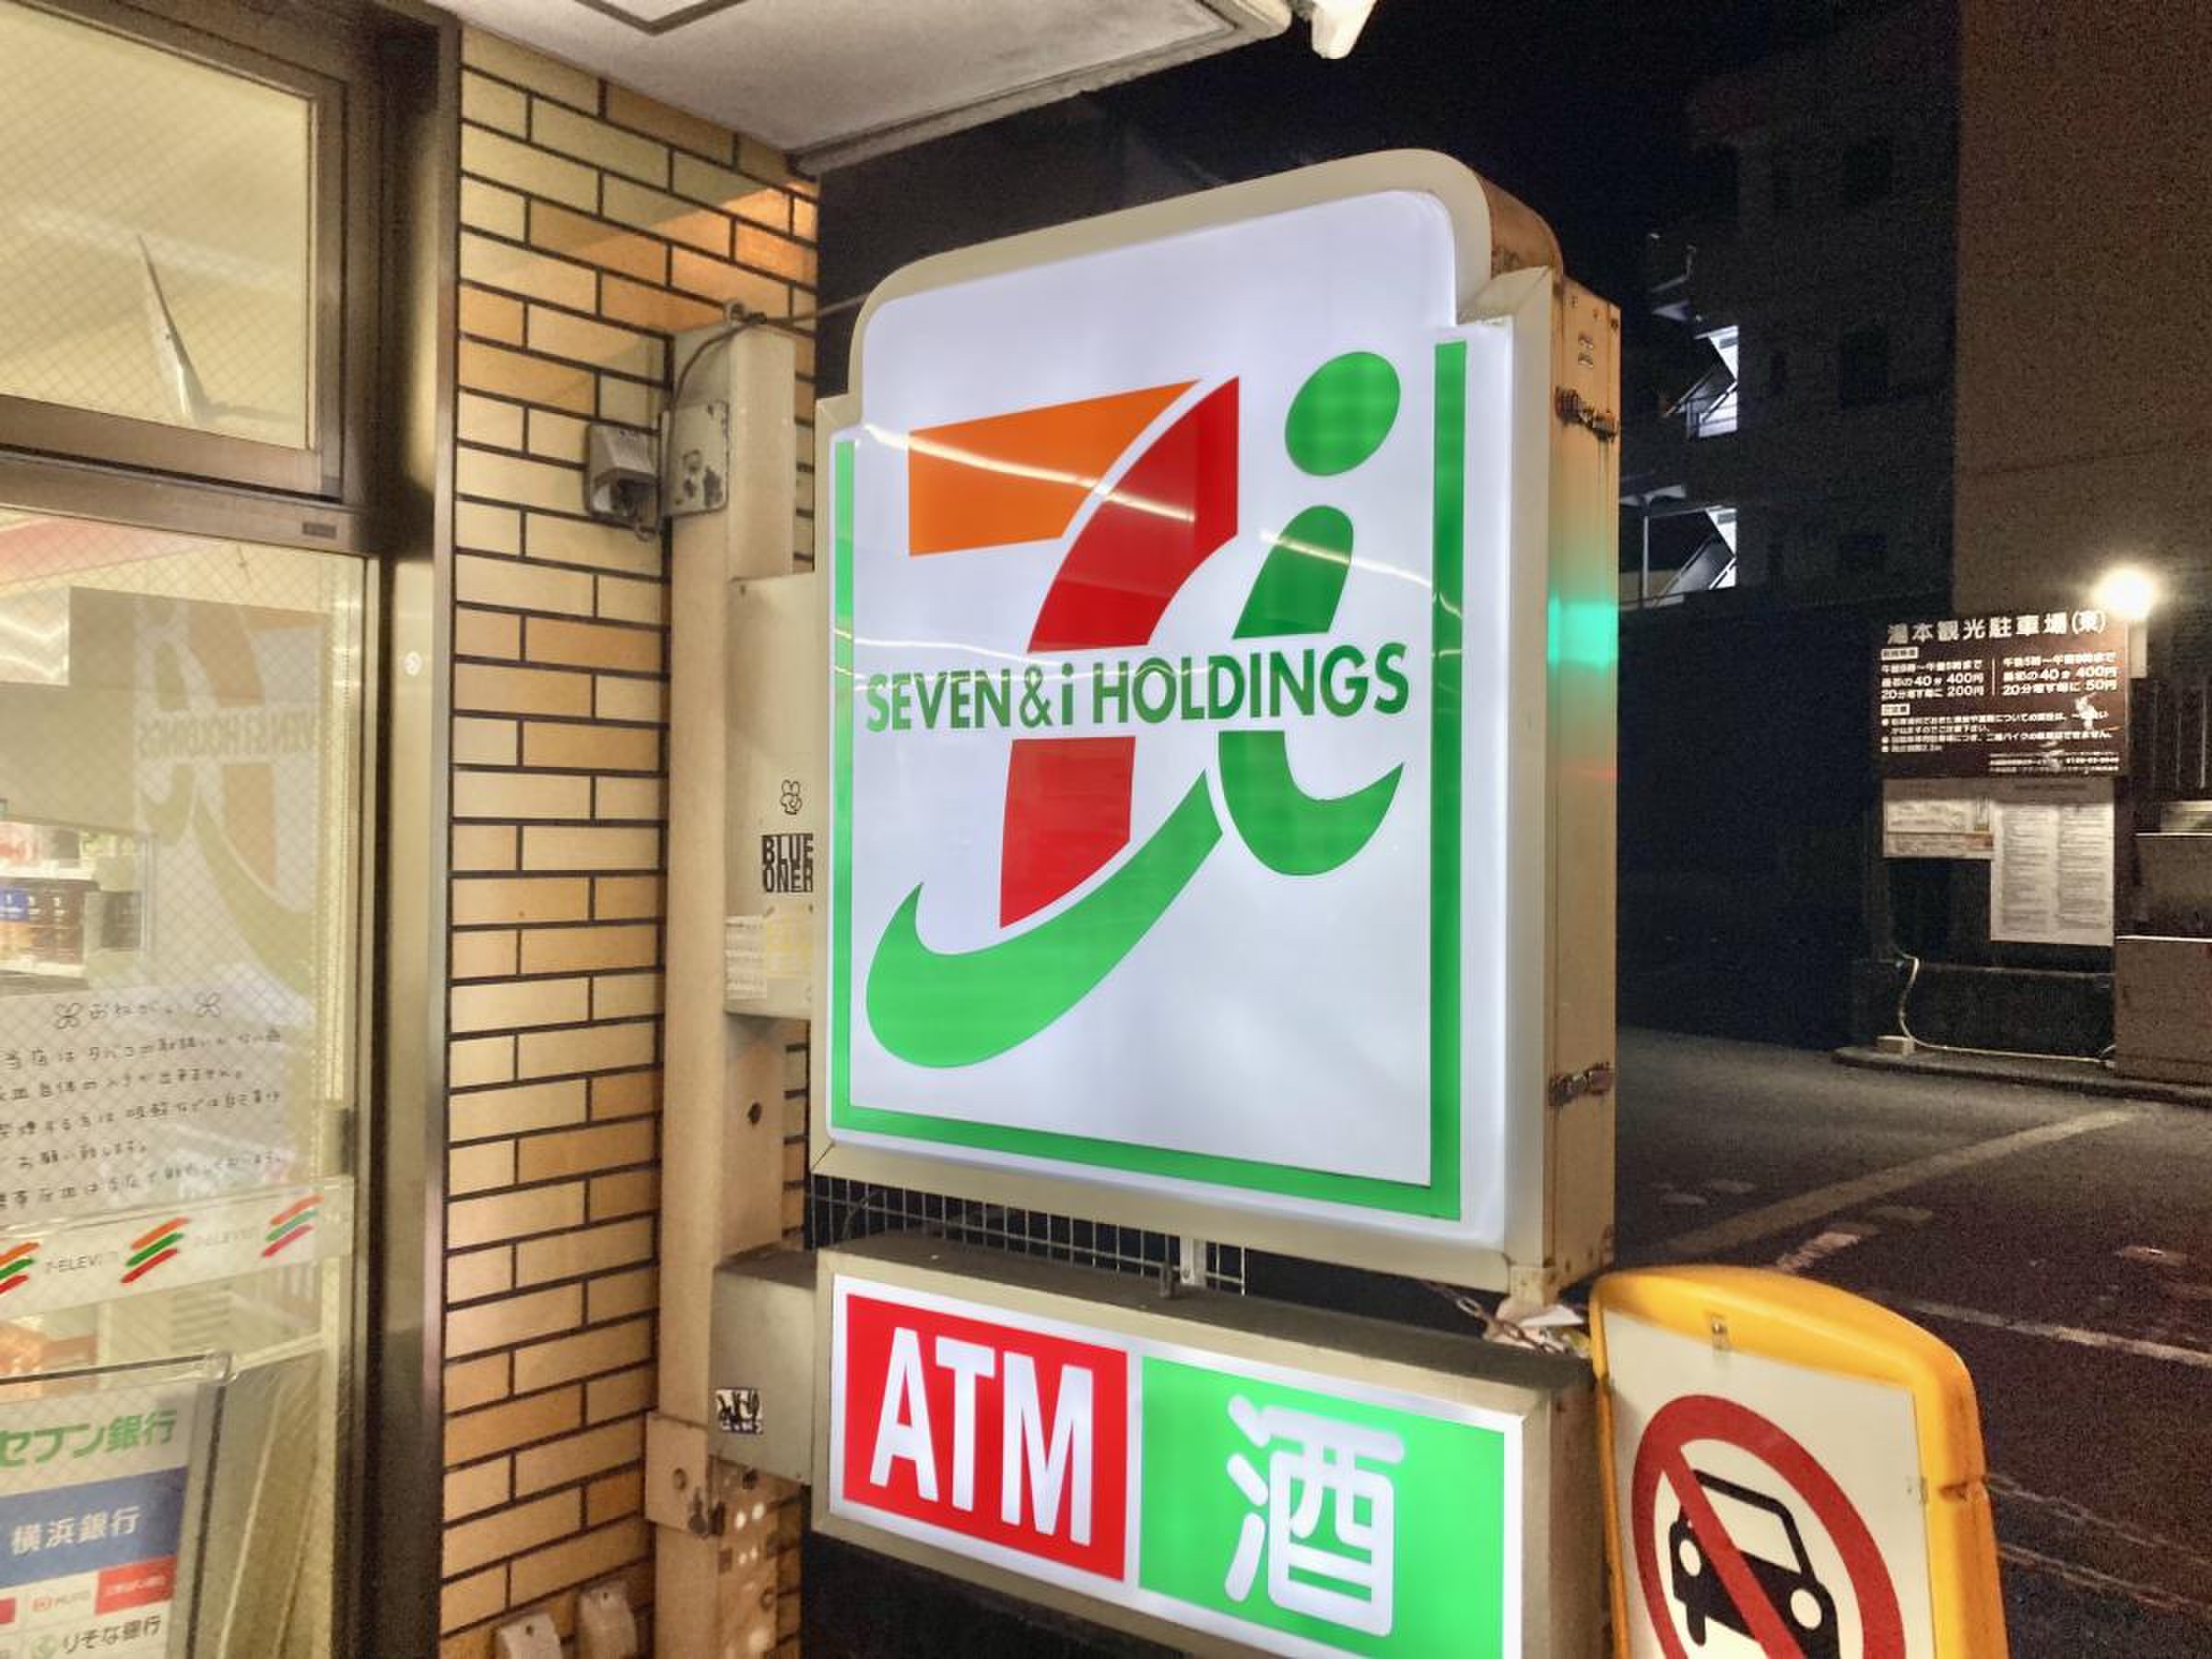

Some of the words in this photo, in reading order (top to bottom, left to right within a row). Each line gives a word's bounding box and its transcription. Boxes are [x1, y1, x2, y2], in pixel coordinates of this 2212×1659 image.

[1093, 643, 1409, 725] HOLDINGS
[762, 833, 813, 864] BLUE
[870, 1326, 1093, 1547] ATM
[10, 1505, 141, 1555] 横浜銀行
[1225, 1394, 1406, 1637] 酒
[63, 1615, 161, 1653] りそな銀行
